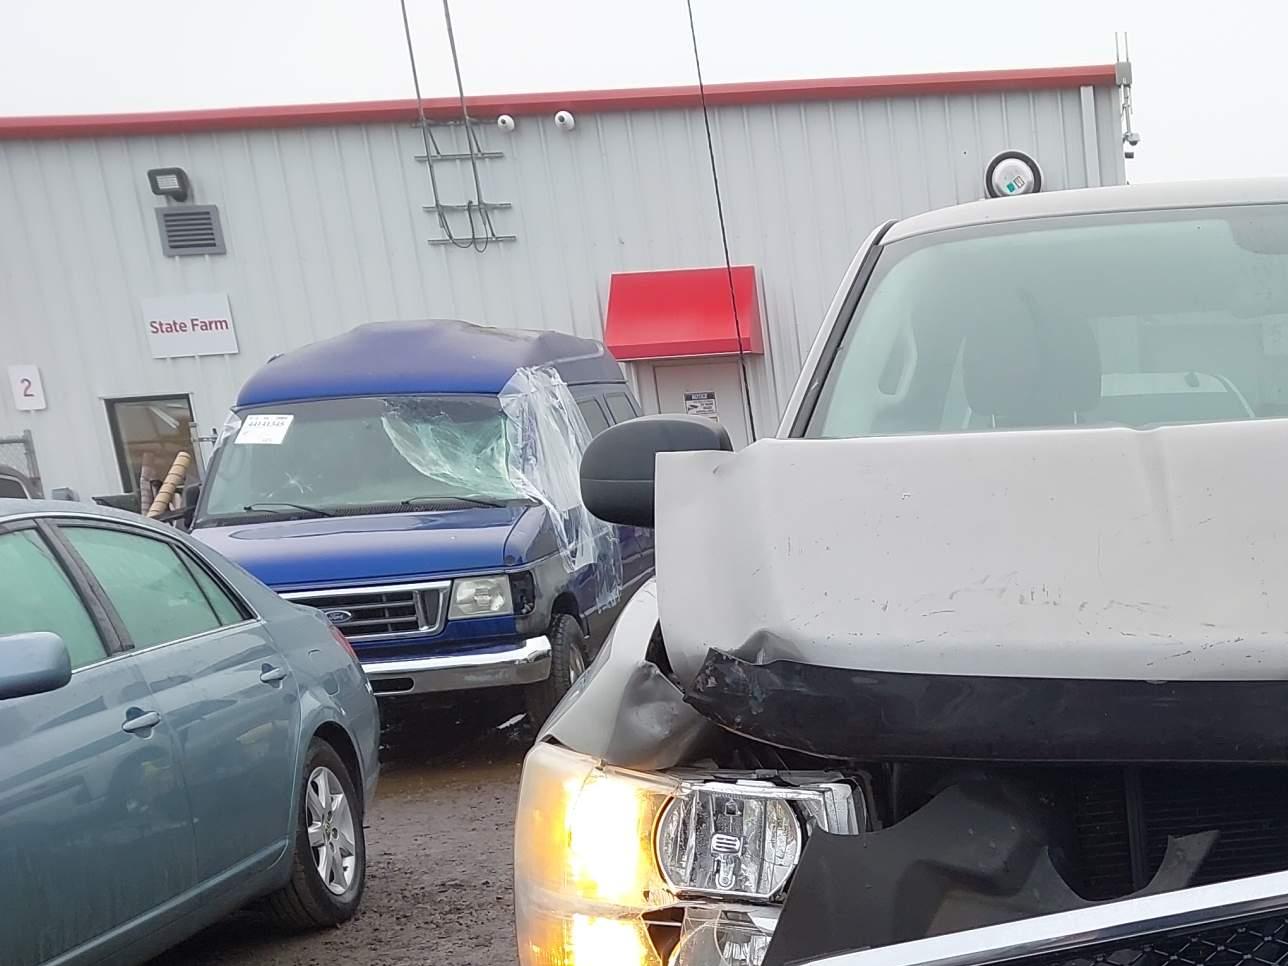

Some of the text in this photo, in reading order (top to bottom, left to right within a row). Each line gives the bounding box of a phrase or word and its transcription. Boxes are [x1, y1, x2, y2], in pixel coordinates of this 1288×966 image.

[150, 318, 229, 334] State Farm
[20, 378, 35, 398] 2
